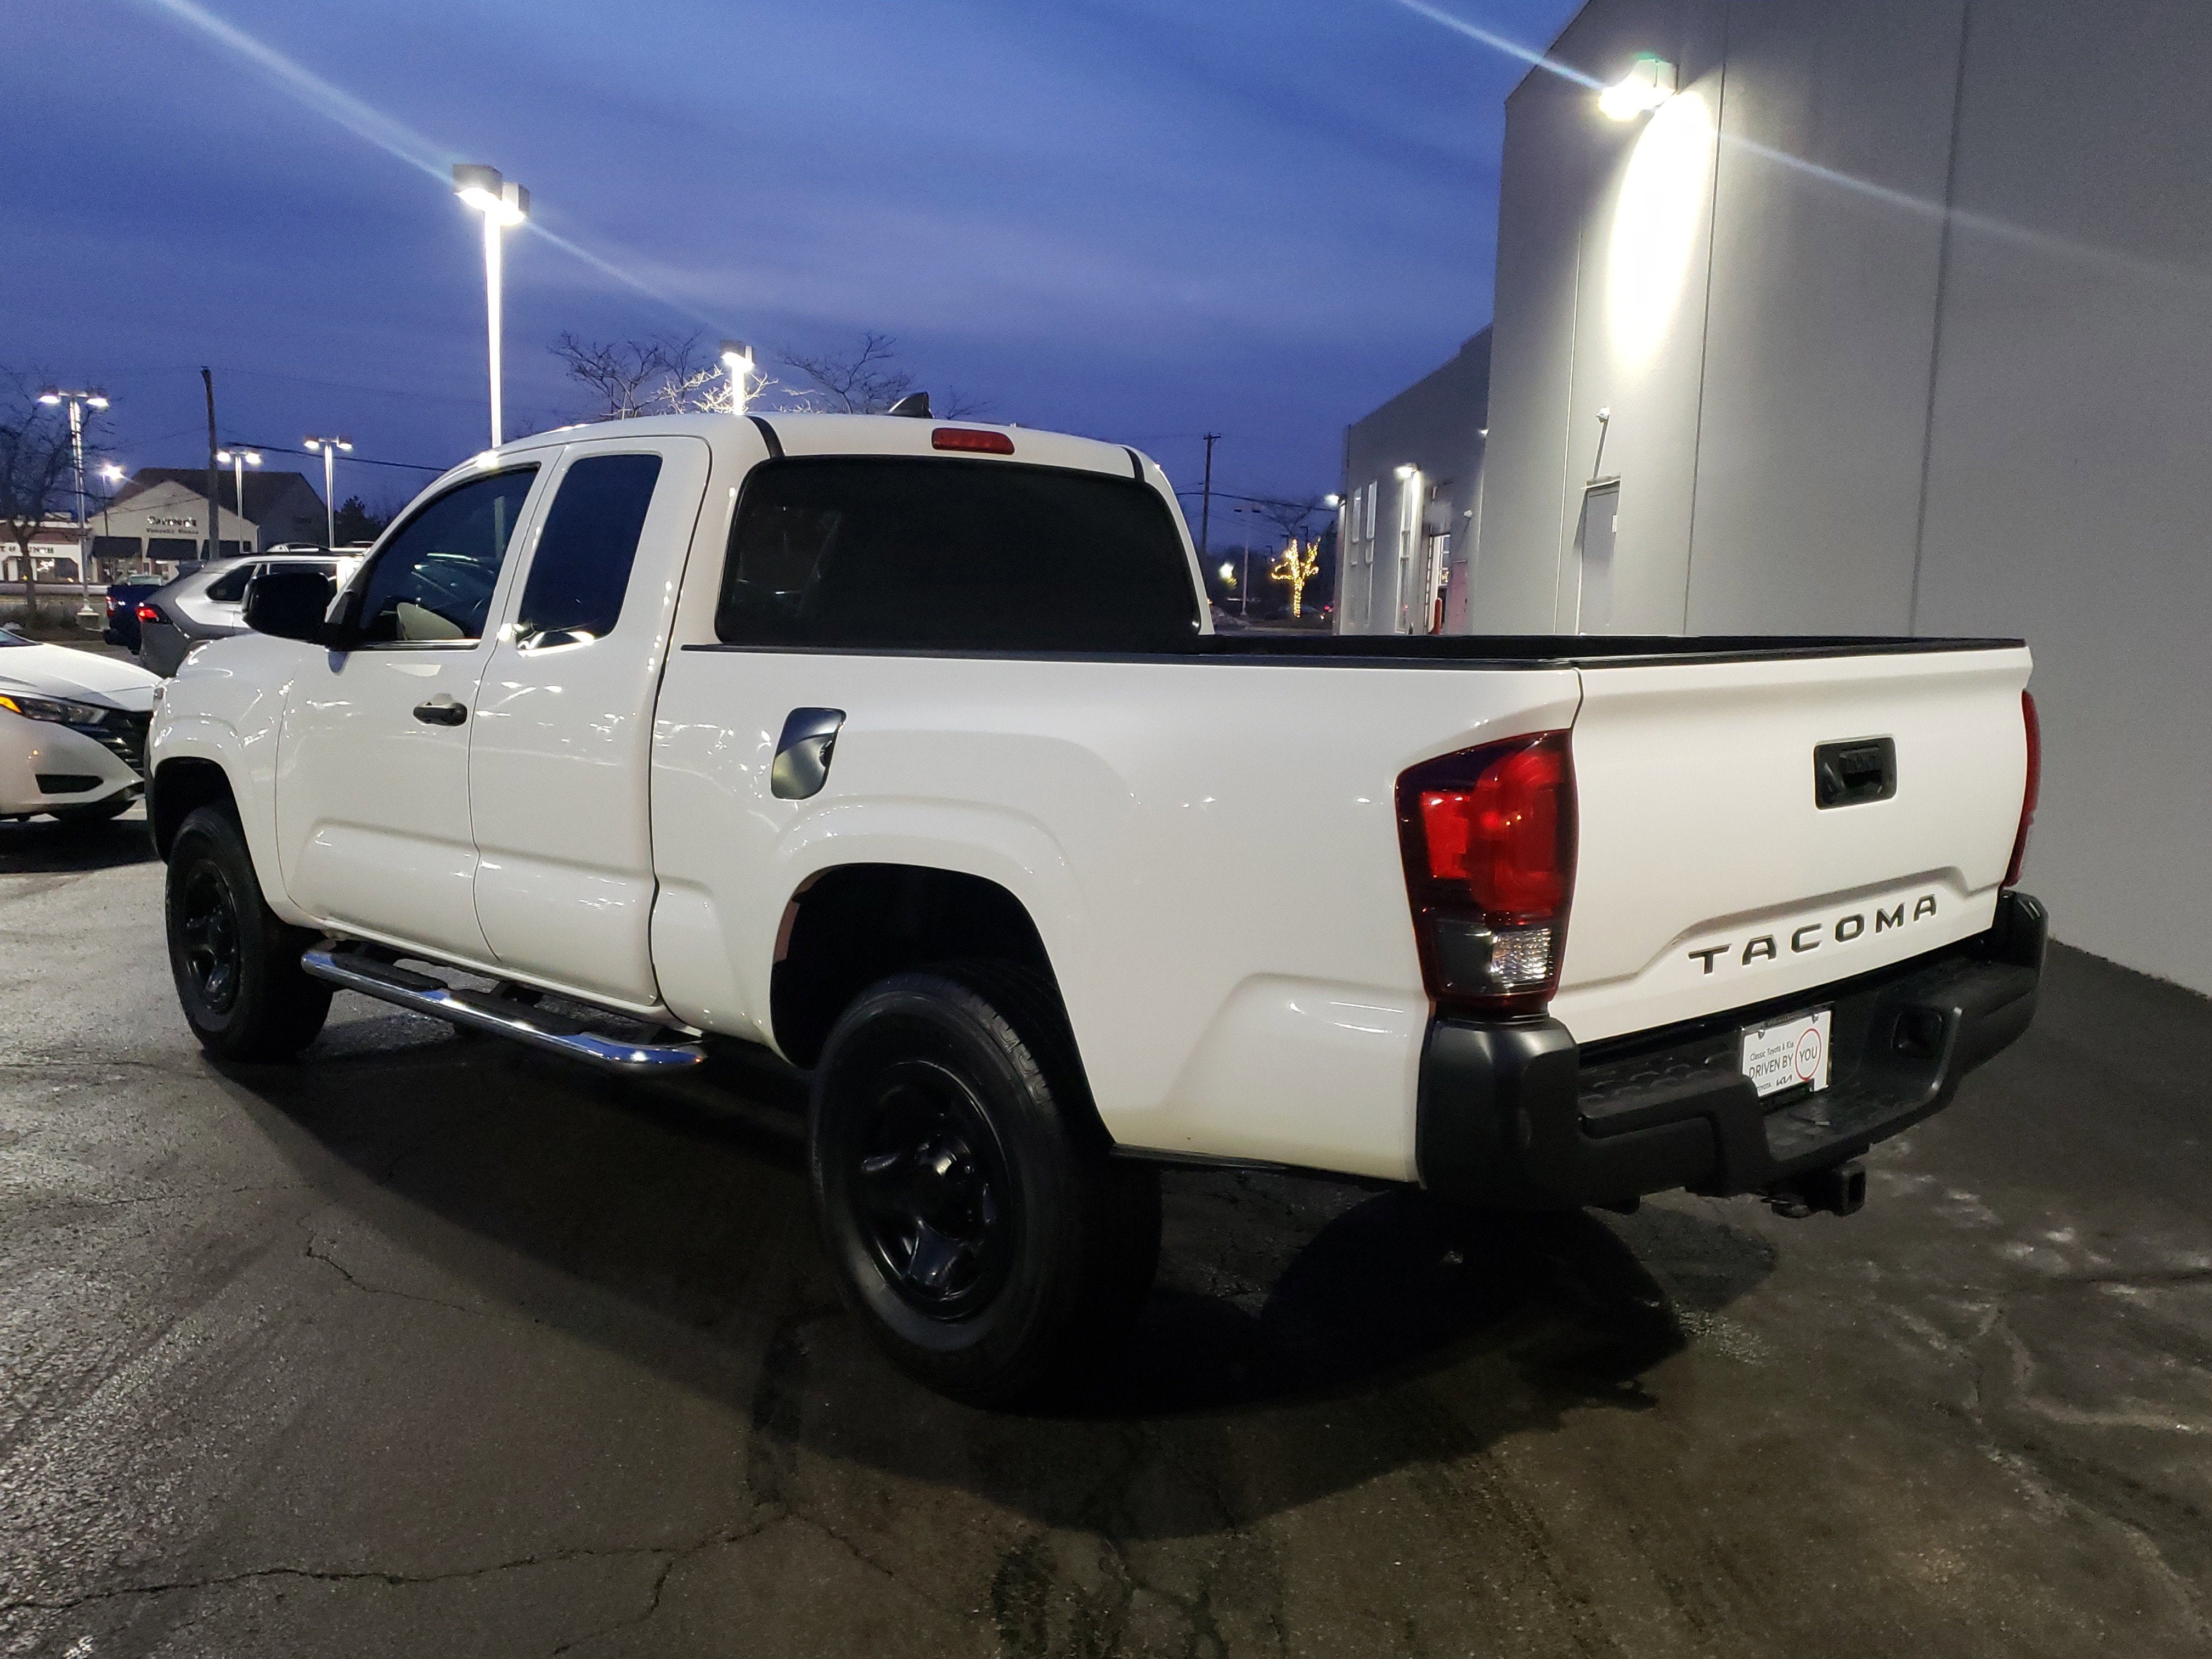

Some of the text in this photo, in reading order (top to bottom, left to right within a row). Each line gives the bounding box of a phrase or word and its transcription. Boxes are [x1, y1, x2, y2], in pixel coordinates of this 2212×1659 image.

[1688, 894, 1937, 974] TACOMA
[1749, 1046, 1818, 1079] DRIVEN BY YOU
[1750, 1051, 1765, 1061] Classic
[1767, 1045, 1781, 1056] Toyota
